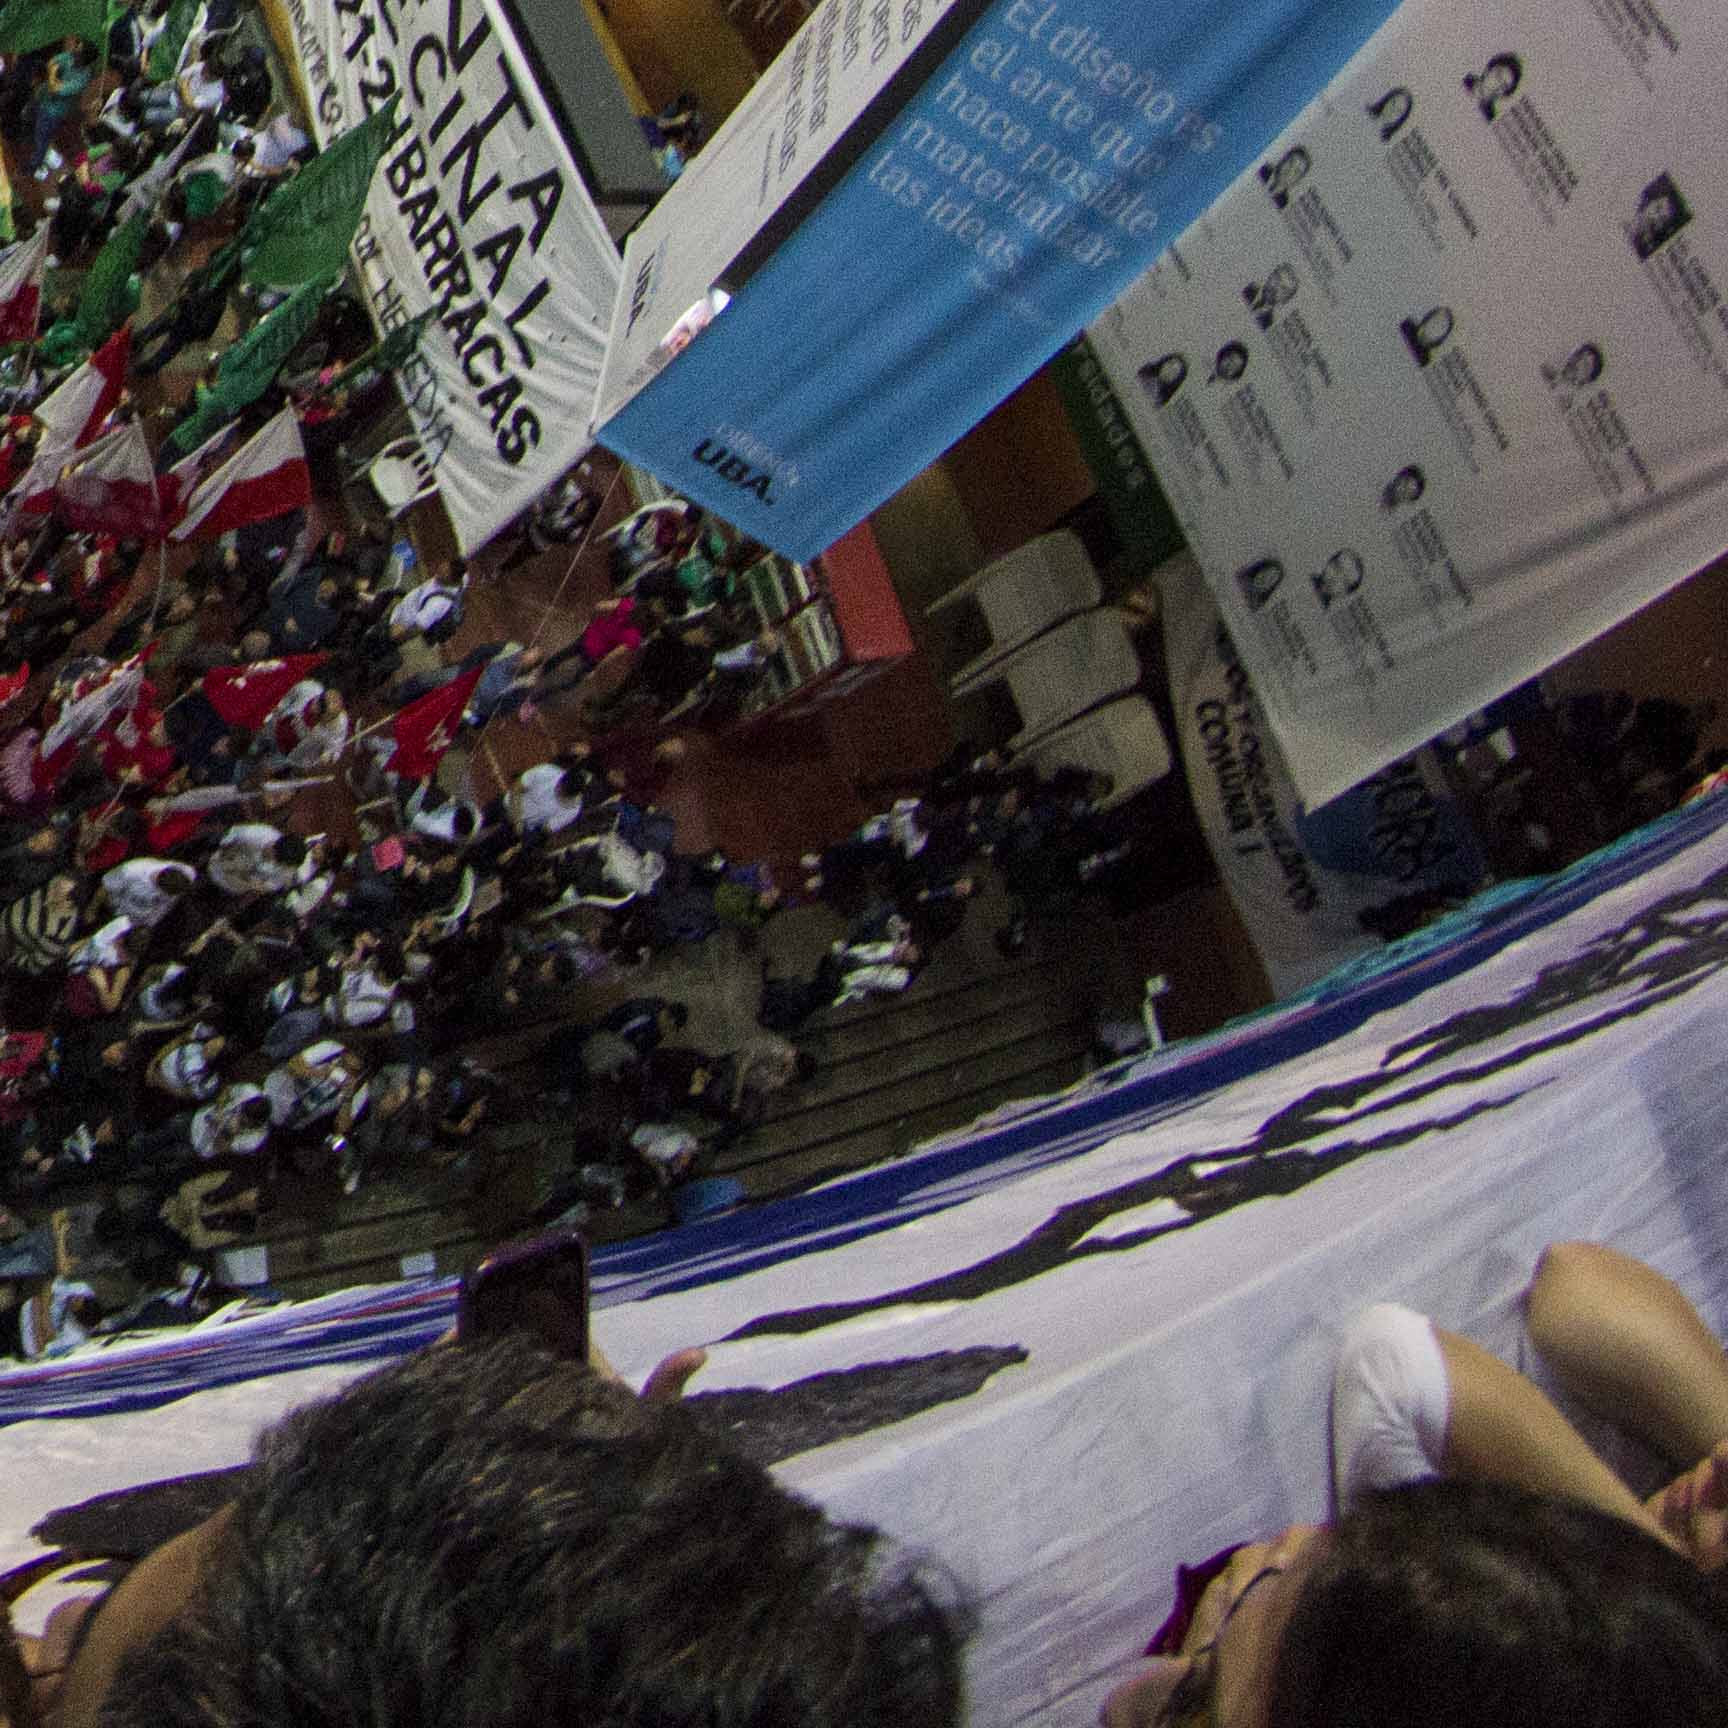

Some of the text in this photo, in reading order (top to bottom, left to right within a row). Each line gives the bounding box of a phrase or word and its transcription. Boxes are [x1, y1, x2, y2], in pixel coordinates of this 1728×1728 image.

[933, 70, 1034, 156] hace
[966, 29, 1023, 83] el
[1007, 60, 1099, 136] arte
[865, 146, 935, 207] las
[385, 145, 543, 463] BARRACAS
